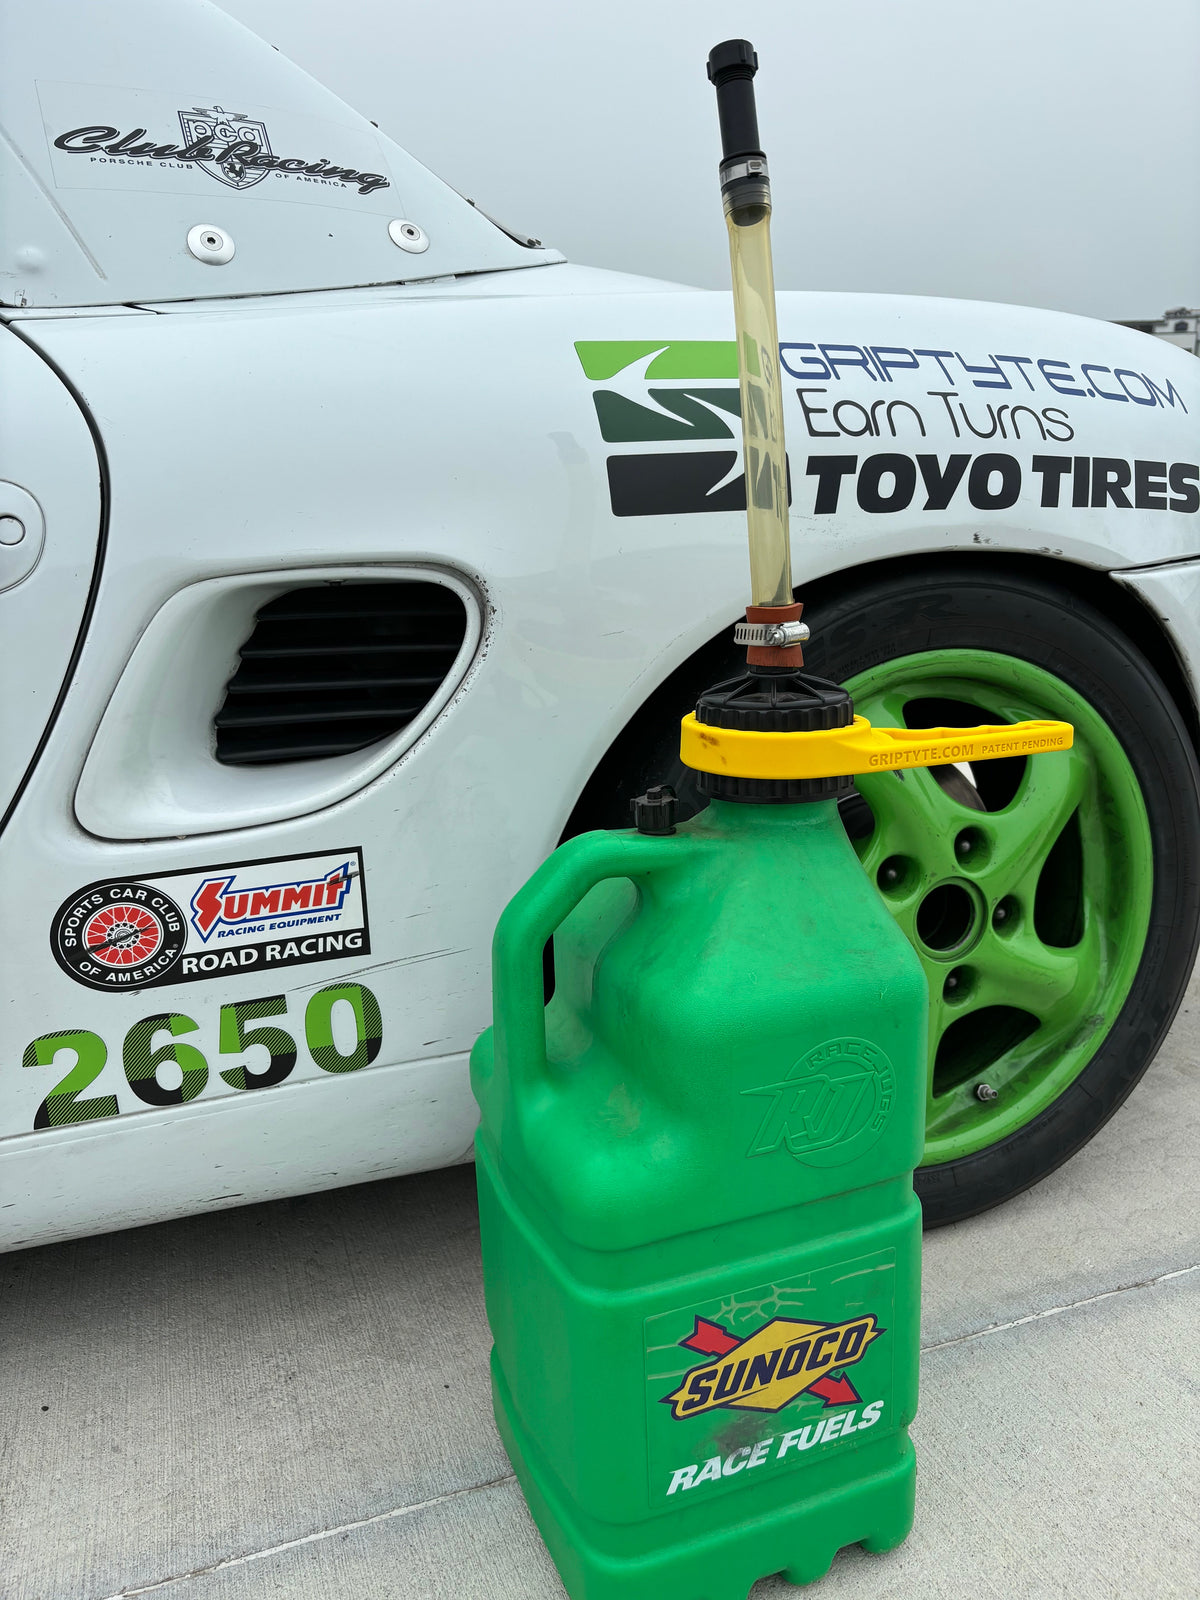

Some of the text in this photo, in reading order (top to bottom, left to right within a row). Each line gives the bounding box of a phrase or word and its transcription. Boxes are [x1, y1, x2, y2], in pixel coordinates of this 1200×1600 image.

[53, 125, 391, 195] Club Racing
[90, 156, 348, 189] PORSCHE CLUB OF AMERICA
[778, 342, 1189, 415] GRIPTYTE.COM
[796, 388, 1075, 442] Earn Turns
[805, 452, 1200, 515] TOYO TIRES
[868, 737, 1064, 767] GRIPTYTE.COM PATENT PENDING
[64, 887, 180, 948] SPORTS CAR CLUB
[194, 870, 348, 937] SUMMIT
[217, 913, 342, 939] RACING EQUIPMENT
[79, 945, 178, 983] OF AMERICA
[181, 931, 364, 975] ROAD RACING
[22, 981, 383, 1131] 2650
[804, 1042, 878, 1071] RACE
[681, 1321, 870, 1412] SUNOCO
[666, 1399, 885, 1496] RACE FUELS
